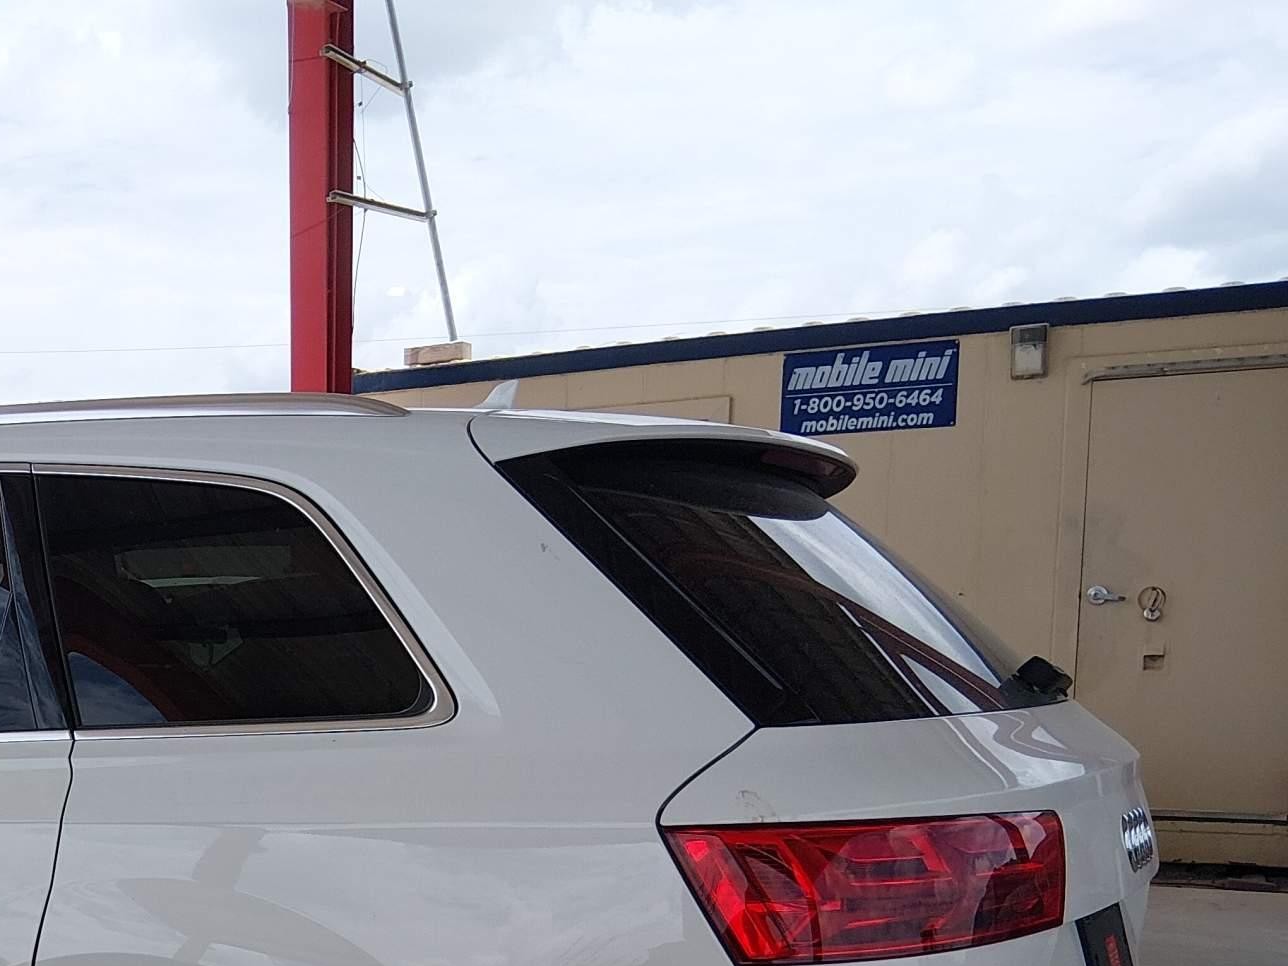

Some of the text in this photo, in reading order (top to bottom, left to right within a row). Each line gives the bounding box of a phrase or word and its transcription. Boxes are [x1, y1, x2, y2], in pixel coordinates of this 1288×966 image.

[787, 348, 953, 391] mobile mini
[793, 387, 943, 415] 1-800-950-6464
[800, 411, 934, 434] mobilemini.com
